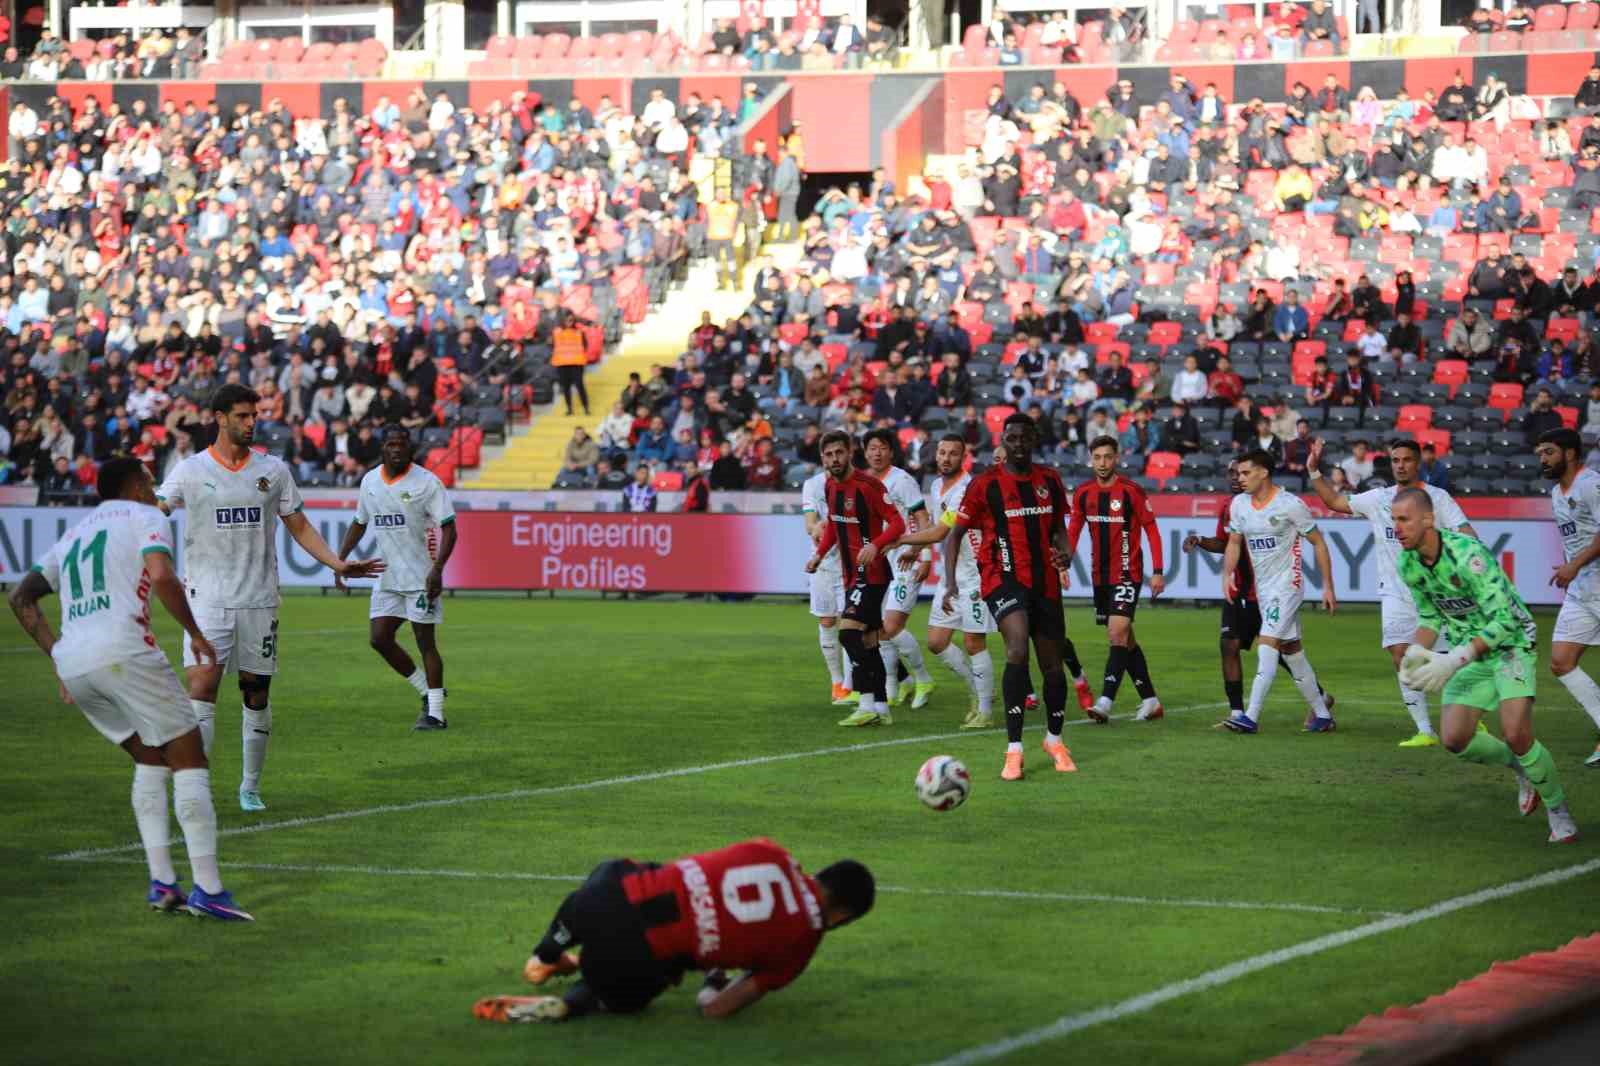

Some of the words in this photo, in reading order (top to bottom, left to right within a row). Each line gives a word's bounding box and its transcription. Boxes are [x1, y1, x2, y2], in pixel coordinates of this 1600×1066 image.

[216, 507, 261, 524] TAV
[512, 515, 672, 556] Engineering
[62, 529, 108, 600] 11
[542, 556, 646, 589] Profiles
[849, 589, 862, 606] 4
[894, 585, 907, 604] 16
[1115, 586, 1135, 603] 23
[69, 594, 110, 621] RUAN
[972, 603, 981, 619] 5
[1266, 607, 1280, 622] 14
[721, 863, 799, 923] 6
